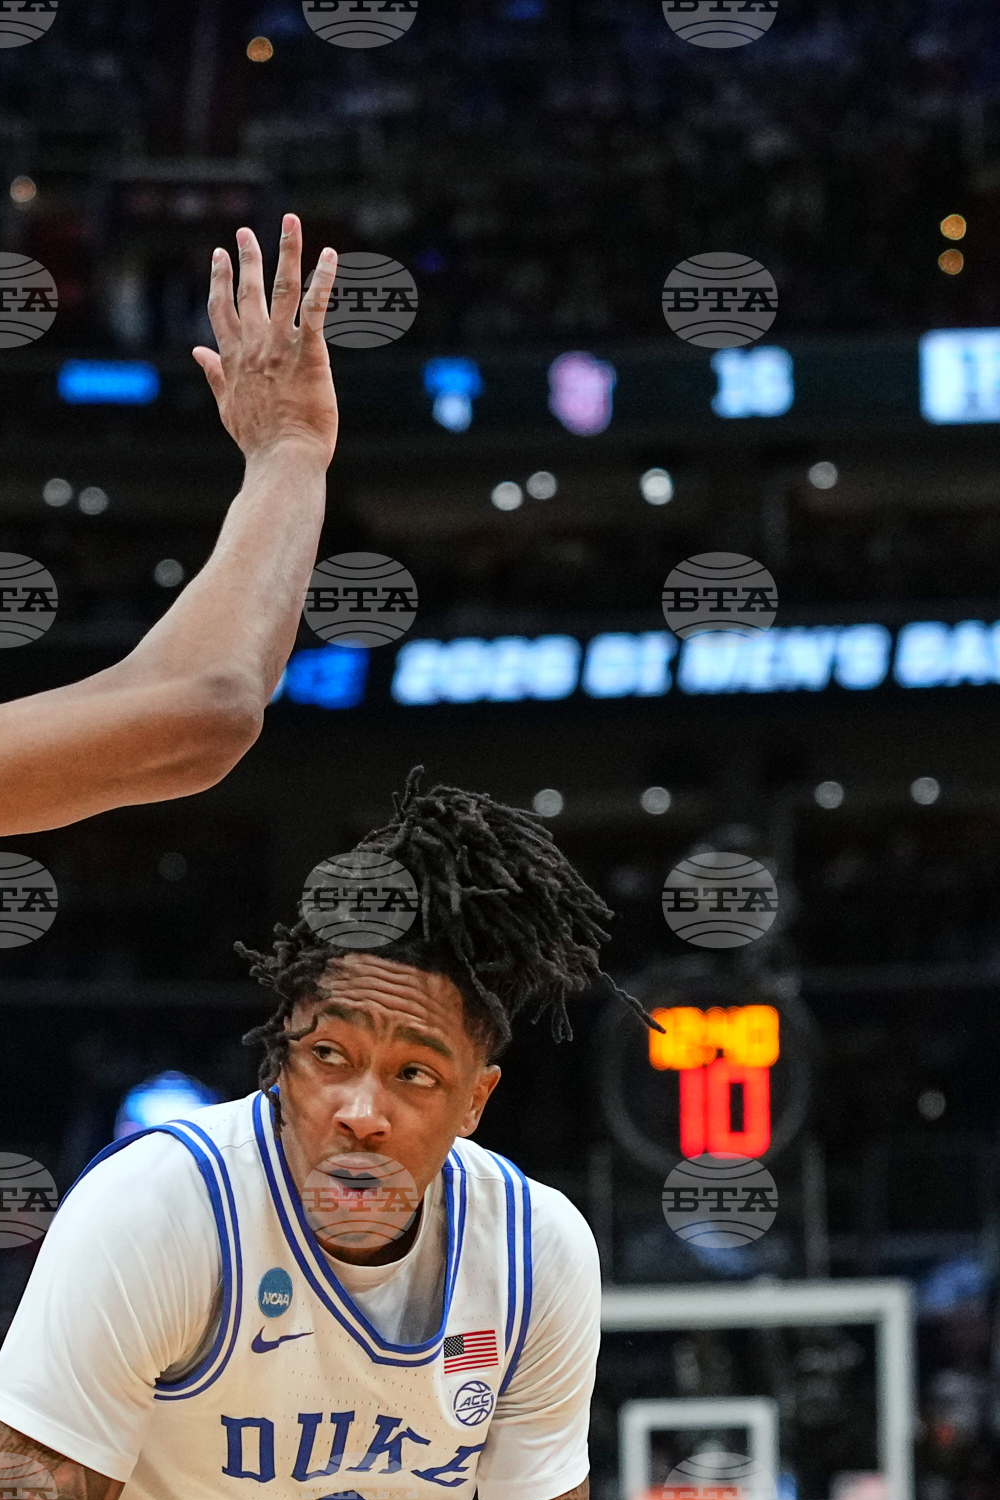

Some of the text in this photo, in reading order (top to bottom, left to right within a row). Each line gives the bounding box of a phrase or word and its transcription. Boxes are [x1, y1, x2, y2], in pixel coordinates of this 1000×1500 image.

[262, 1292, 290, 1306] NCAA
[459, 1392, 492, 1408] ACC
[221, 1410, 486, 1487] DUKE
